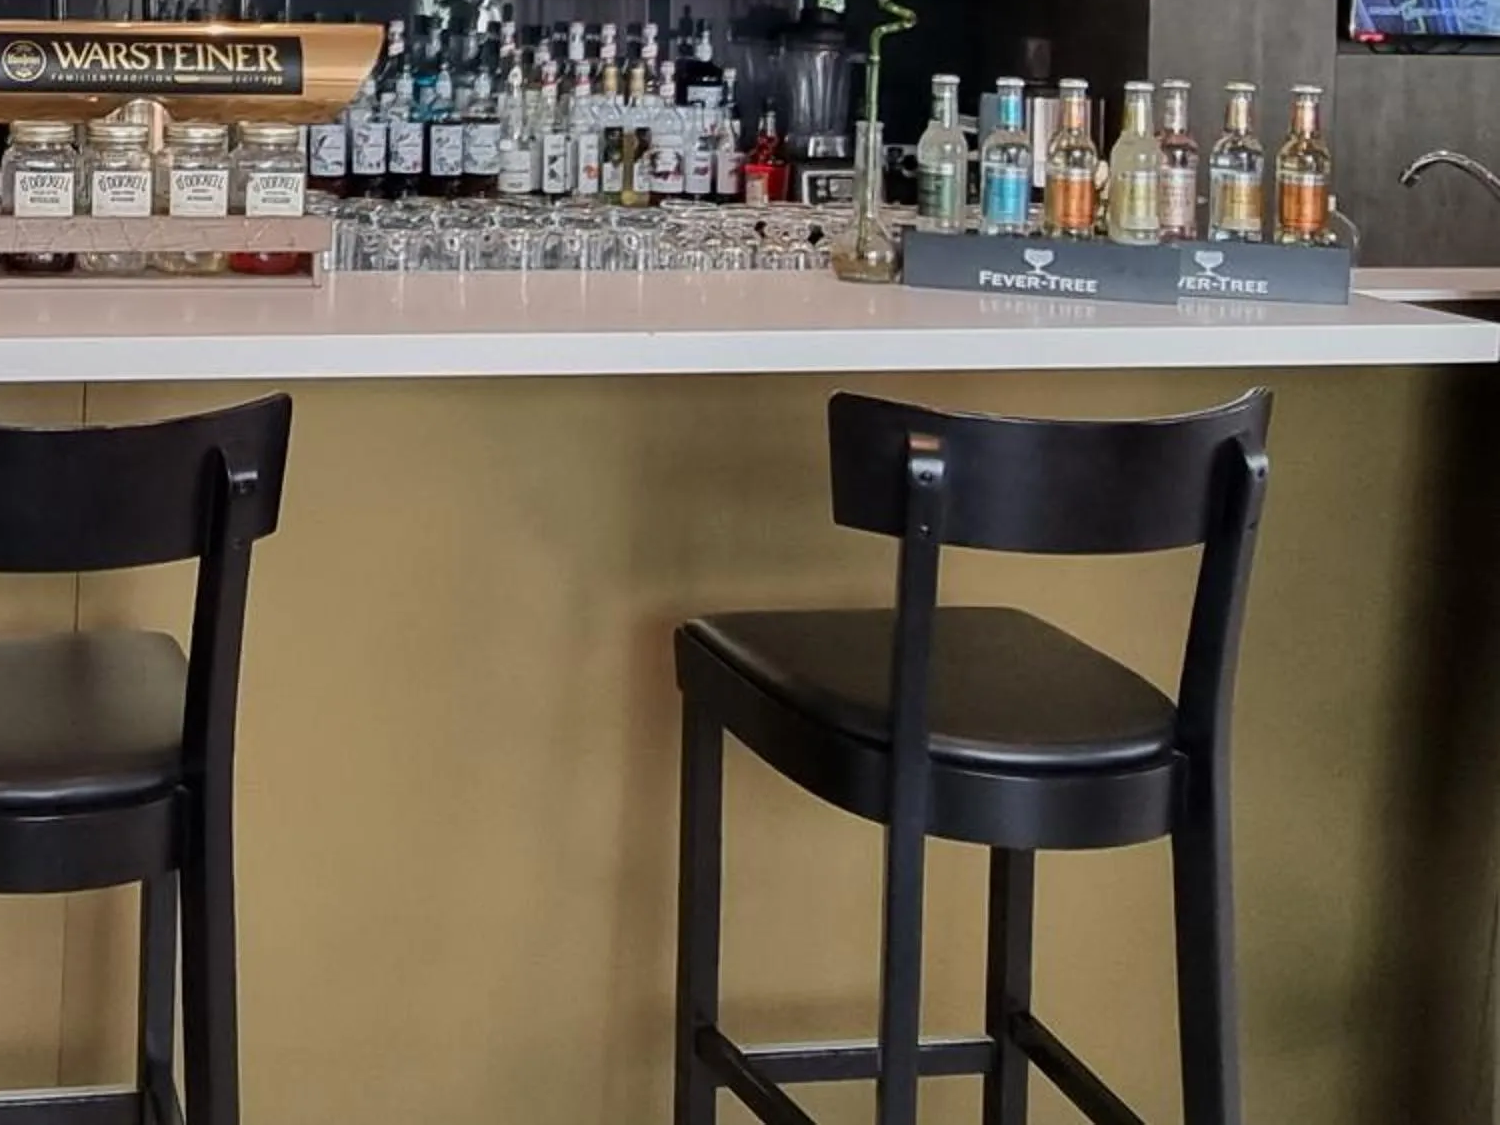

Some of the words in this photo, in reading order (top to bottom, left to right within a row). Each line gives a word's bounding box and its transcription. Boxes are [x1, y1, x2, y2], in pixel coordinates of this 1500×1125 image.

[51, 41, 283, 72] WARSTEINER
[979, 270, 1100, 293] FEVER-TREE
[1177, 275, 1269, 294] VER-TREE
